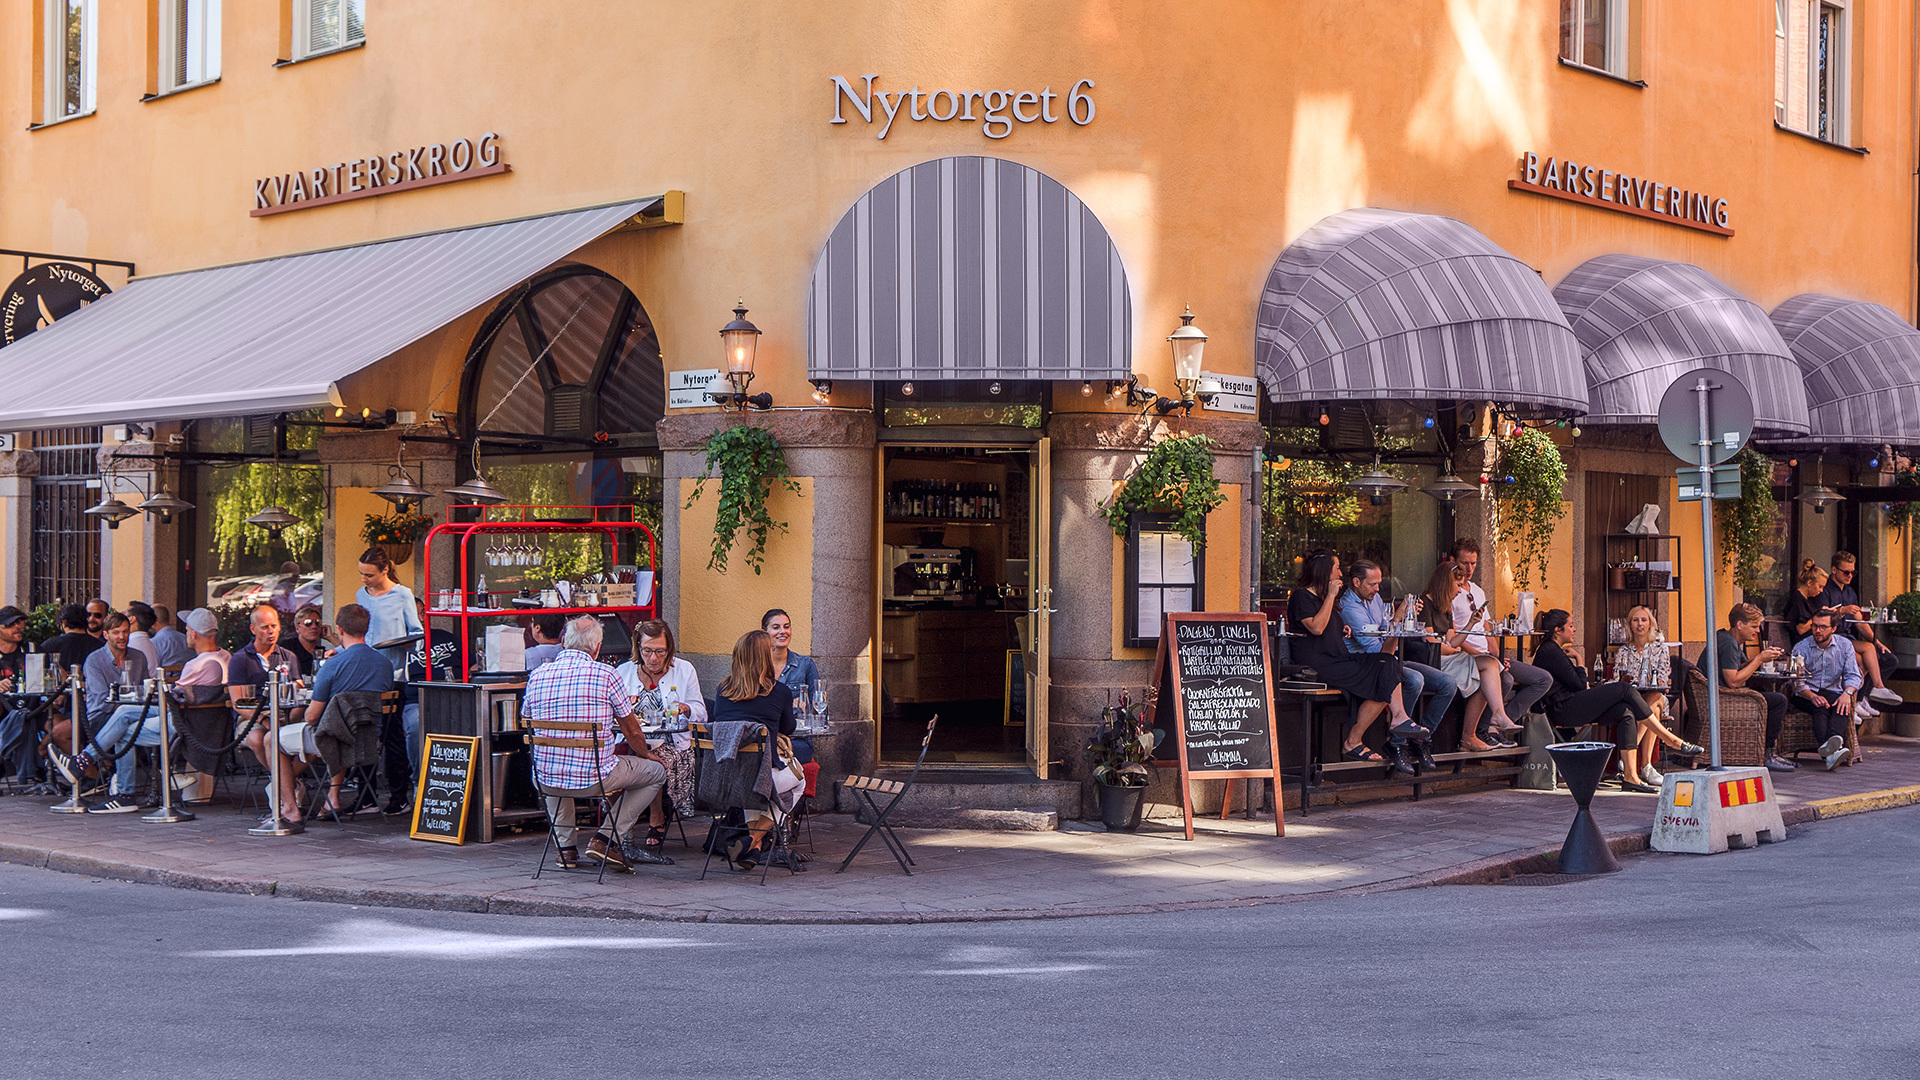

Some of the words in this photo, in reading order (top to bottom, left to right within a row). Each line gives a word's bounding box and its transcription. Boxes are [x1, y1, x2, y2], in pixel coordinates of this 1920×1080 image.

[828, 73, 1060, 140] Nytorget
[1067, 78, 1096, 126] 6
[254, 131, 500, 209] KVARTERSKROG
[1522, 151, 1729, 228] BARSERVERING
[48, 264, 103, 296] Nytorget
[1219, 377, 1253, 393] kesgatan
[1180, 625, 1216, 639] DAGENS
[1220, 625, 1251, 639] LUNCH
[1662, 815, 1700, 828] SVEVIA
